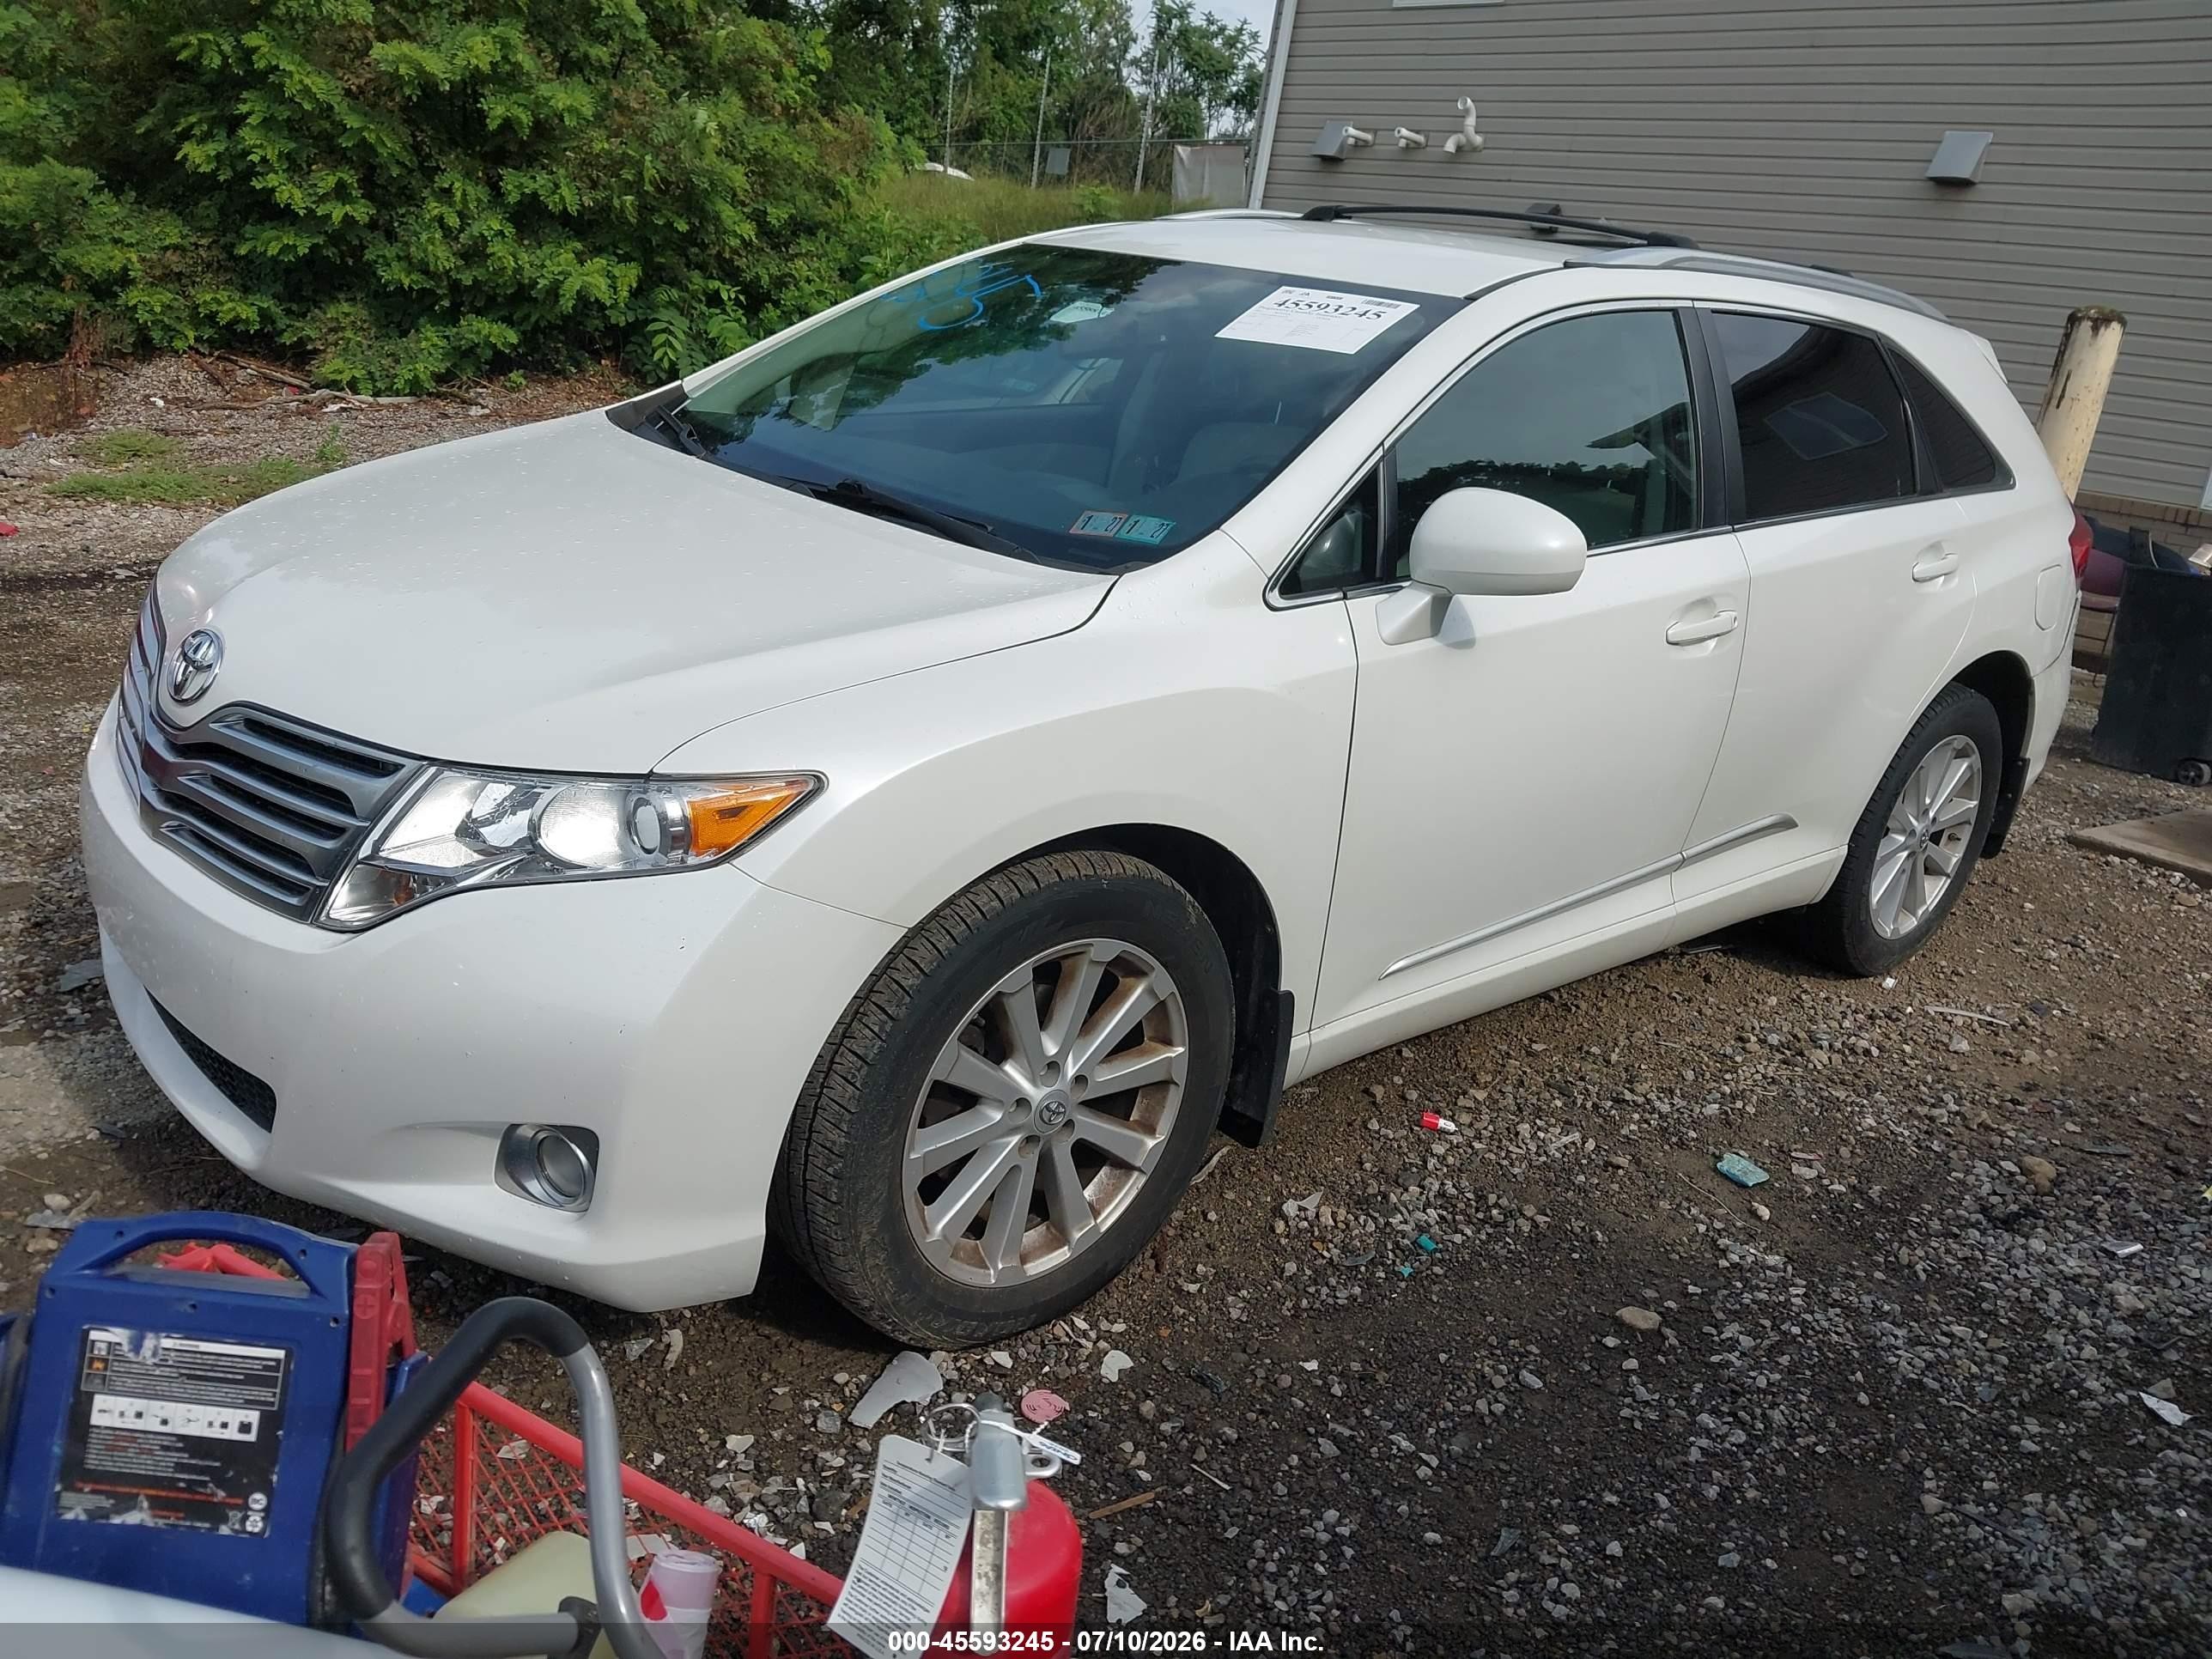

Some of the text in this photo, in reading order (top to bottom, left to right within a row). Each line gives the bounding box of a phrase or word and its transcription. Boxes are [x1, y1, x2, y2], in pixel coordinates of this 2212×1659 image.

[1274, 298, 1388, 321] 45593245
[1104, 516, 1123, 533] 27
[1151, 522, 1170, 538] 27
